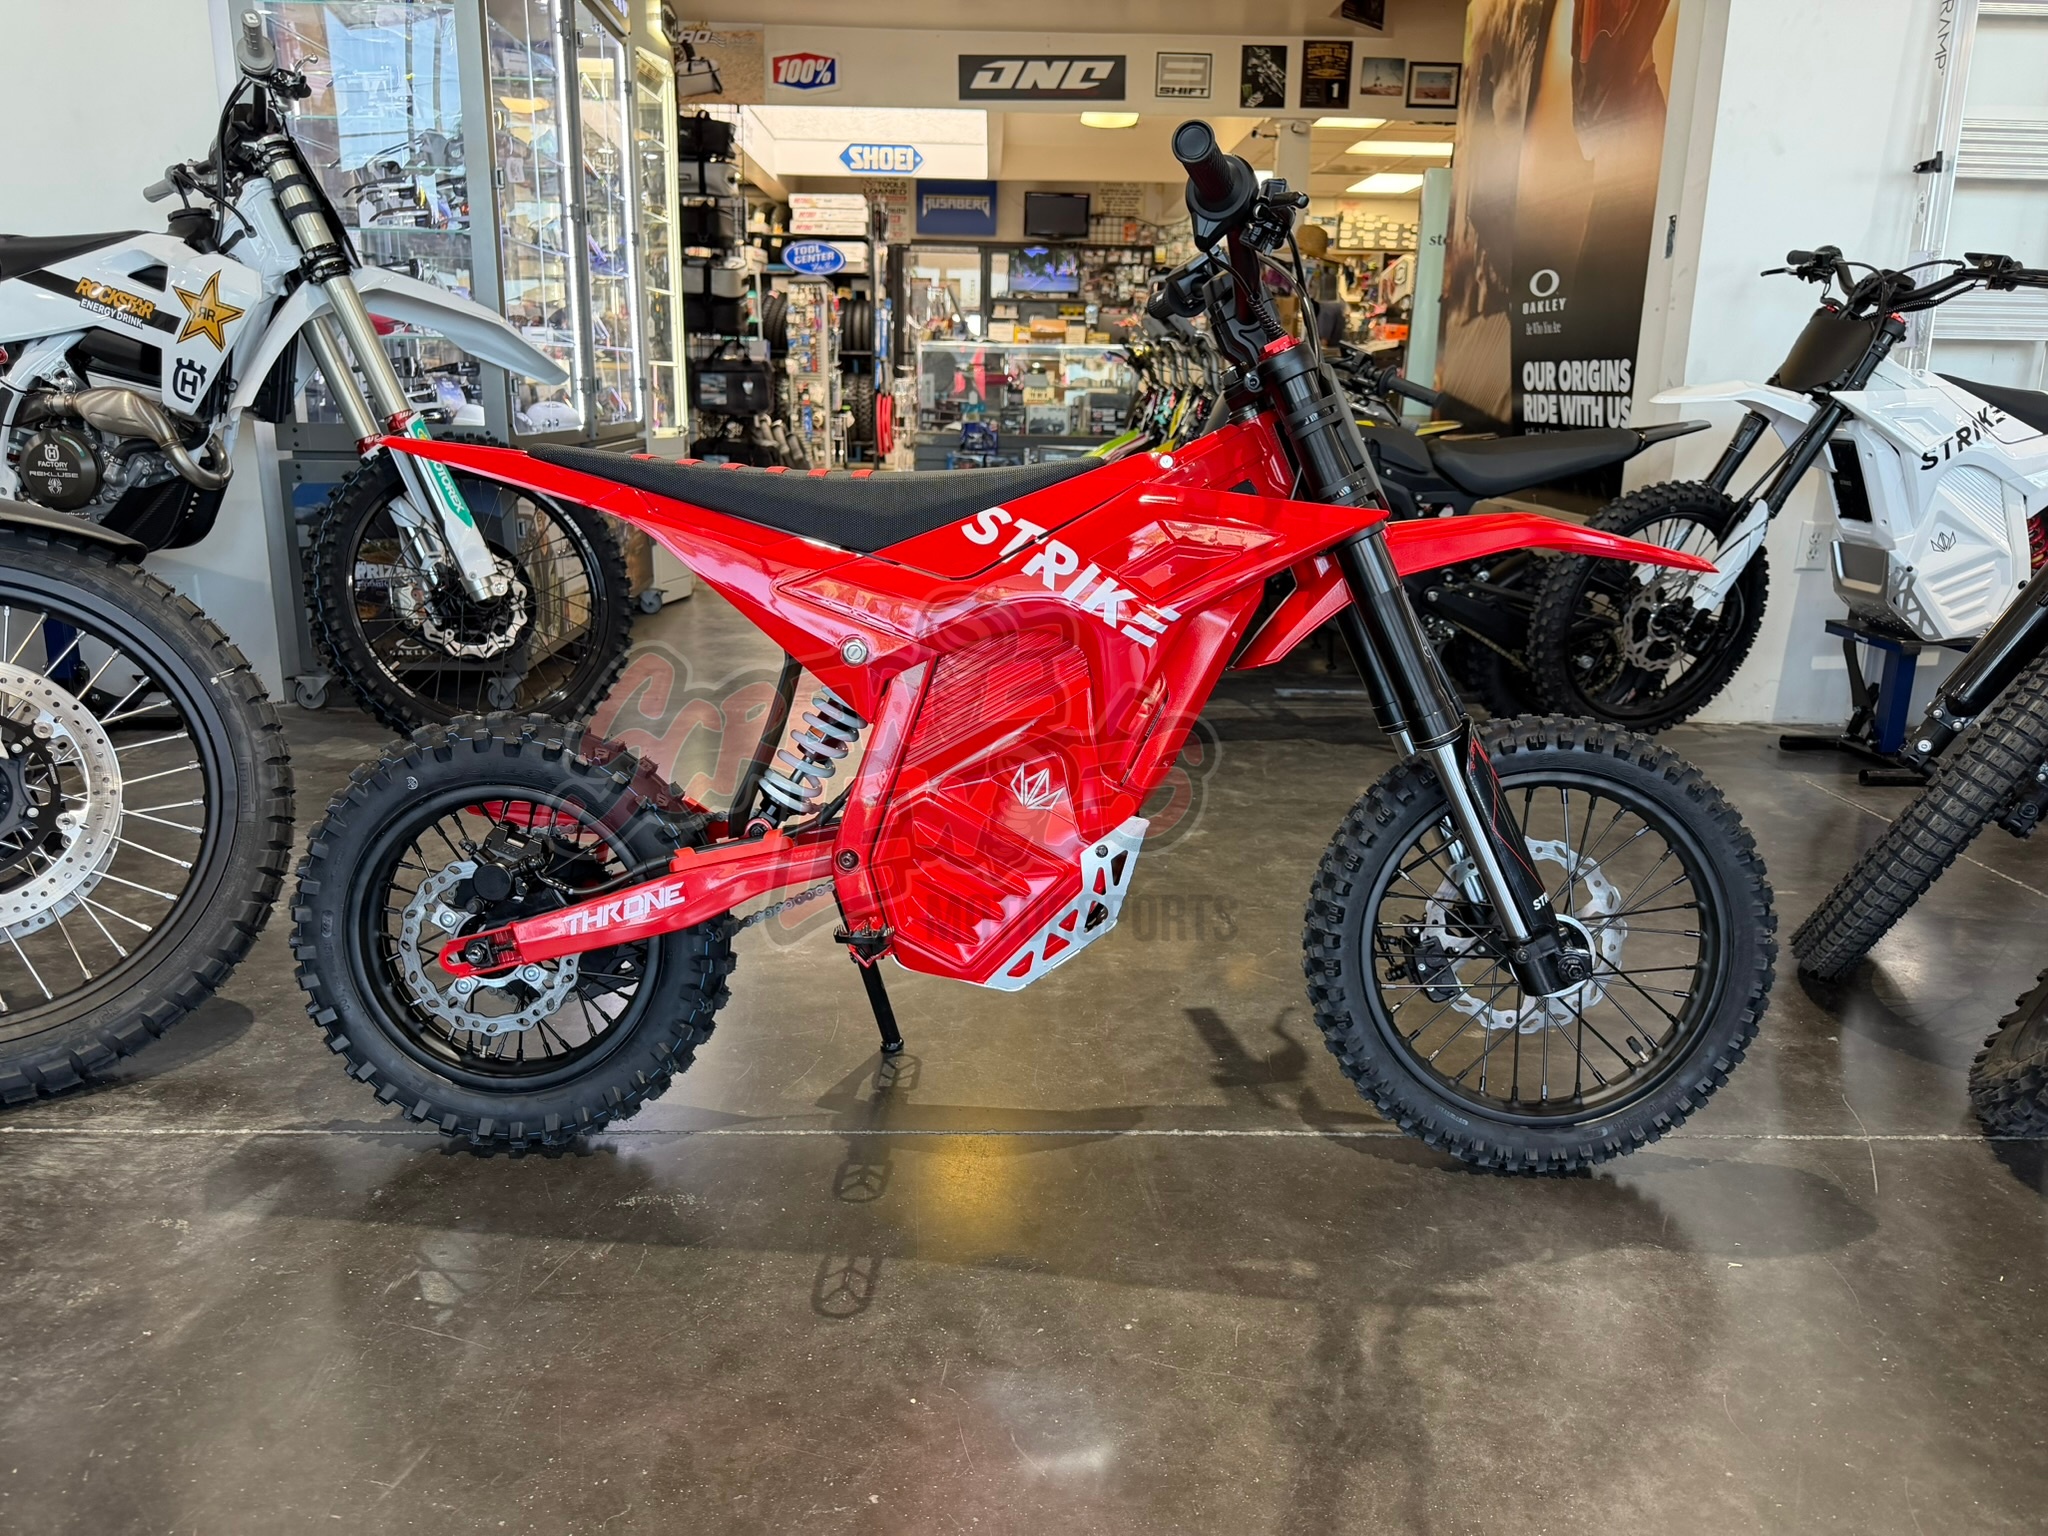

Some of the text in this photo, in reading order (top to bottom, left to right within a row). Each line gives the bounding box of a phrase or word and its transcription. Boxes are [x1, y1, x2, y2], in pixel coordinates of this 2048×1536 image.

[778, 59, 831, 84] 100%
[1160, 87, 1207, 95] SHIFT
[848, 146, 914, 170] SHOEI
[793, 244, 821, 256] TOOL
[793, 251, 835, 265] CENTER
[75, 277, 156, 319] ROCKSTAR
[1522, 298, 1567, 315] OAKLEY
[80, 298, 144, 329] ENERGY DRINK
[1523, 358, 1632, 393] OUR ORIGINS
[1523, 394, 1632, 429] RIDE WITH US
[38, 460, 68, 468] FACTORY
[433, 461, 465, 514] OTOREX
[961, 507, 1181, 648] STRIKE
[562, 882, 685, 936] THRONE
